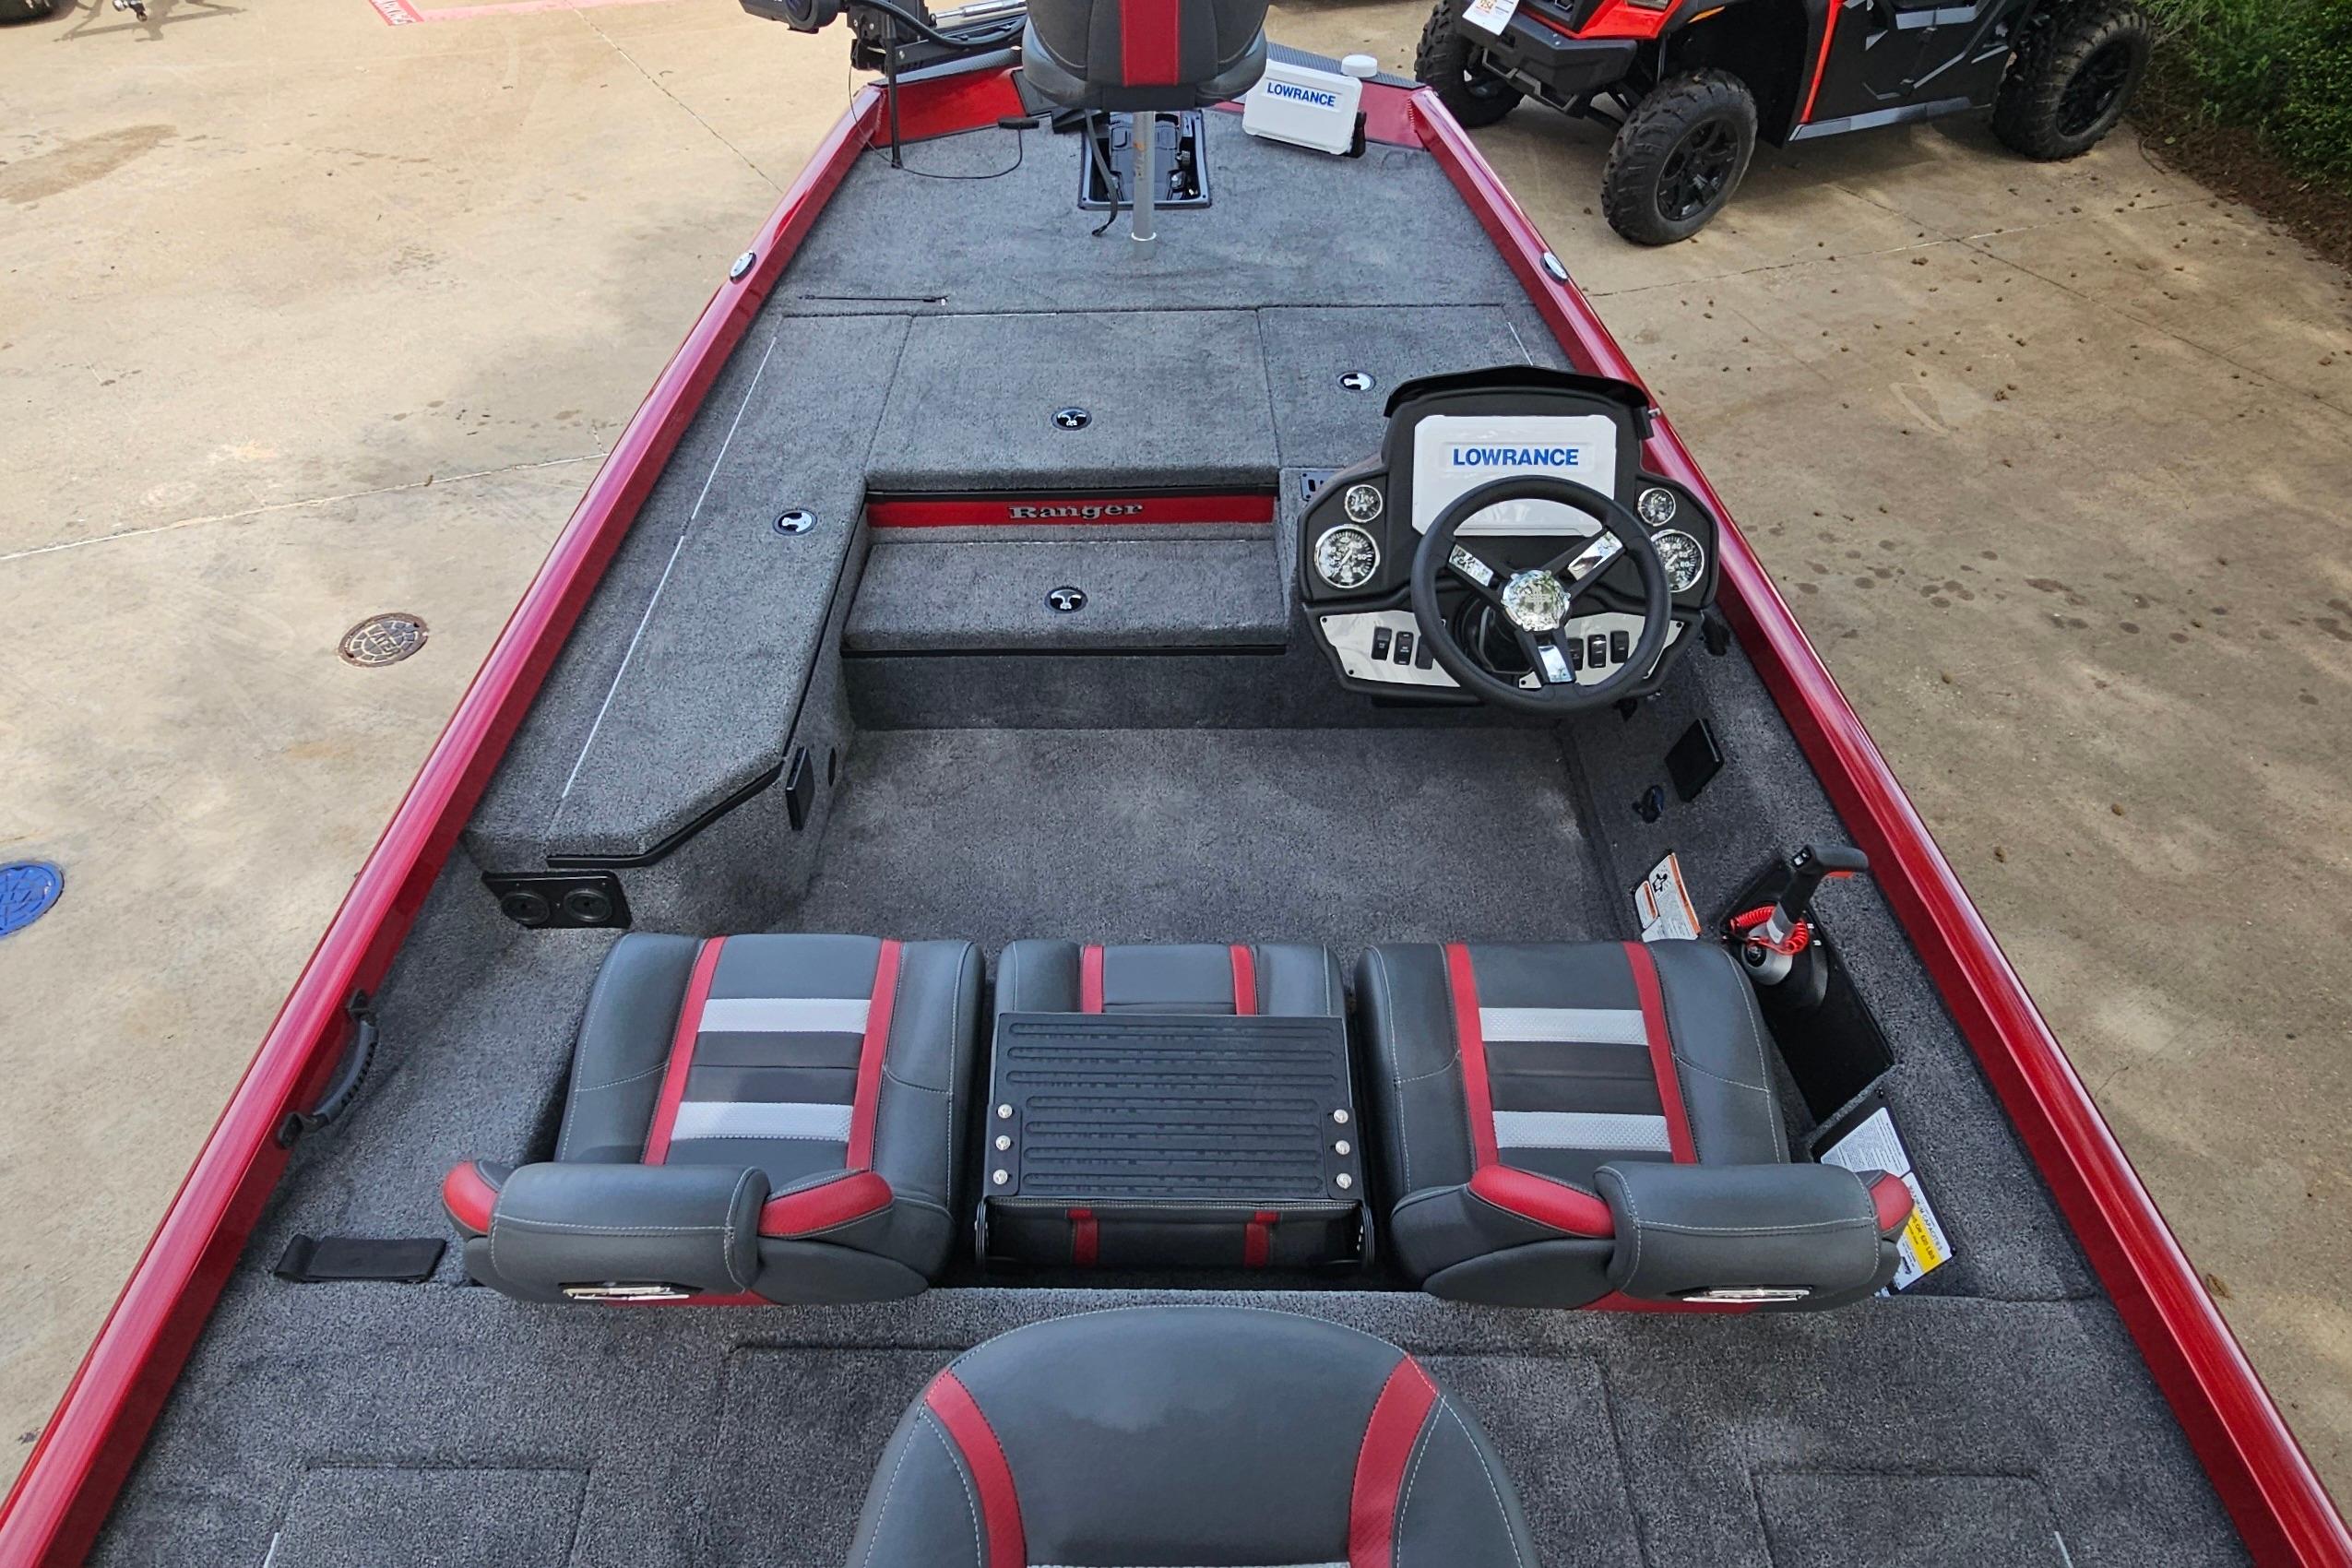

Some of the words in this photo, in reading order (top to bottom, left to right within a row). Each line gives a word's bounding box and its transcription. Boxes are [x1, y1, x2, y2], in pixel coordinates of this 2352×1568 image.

[1266, 82, 1336, 107] LOWRANCE
[1453, 448, 1579, 467] LOWRANCE
[1009, 505, 1143, 519] Ranger
